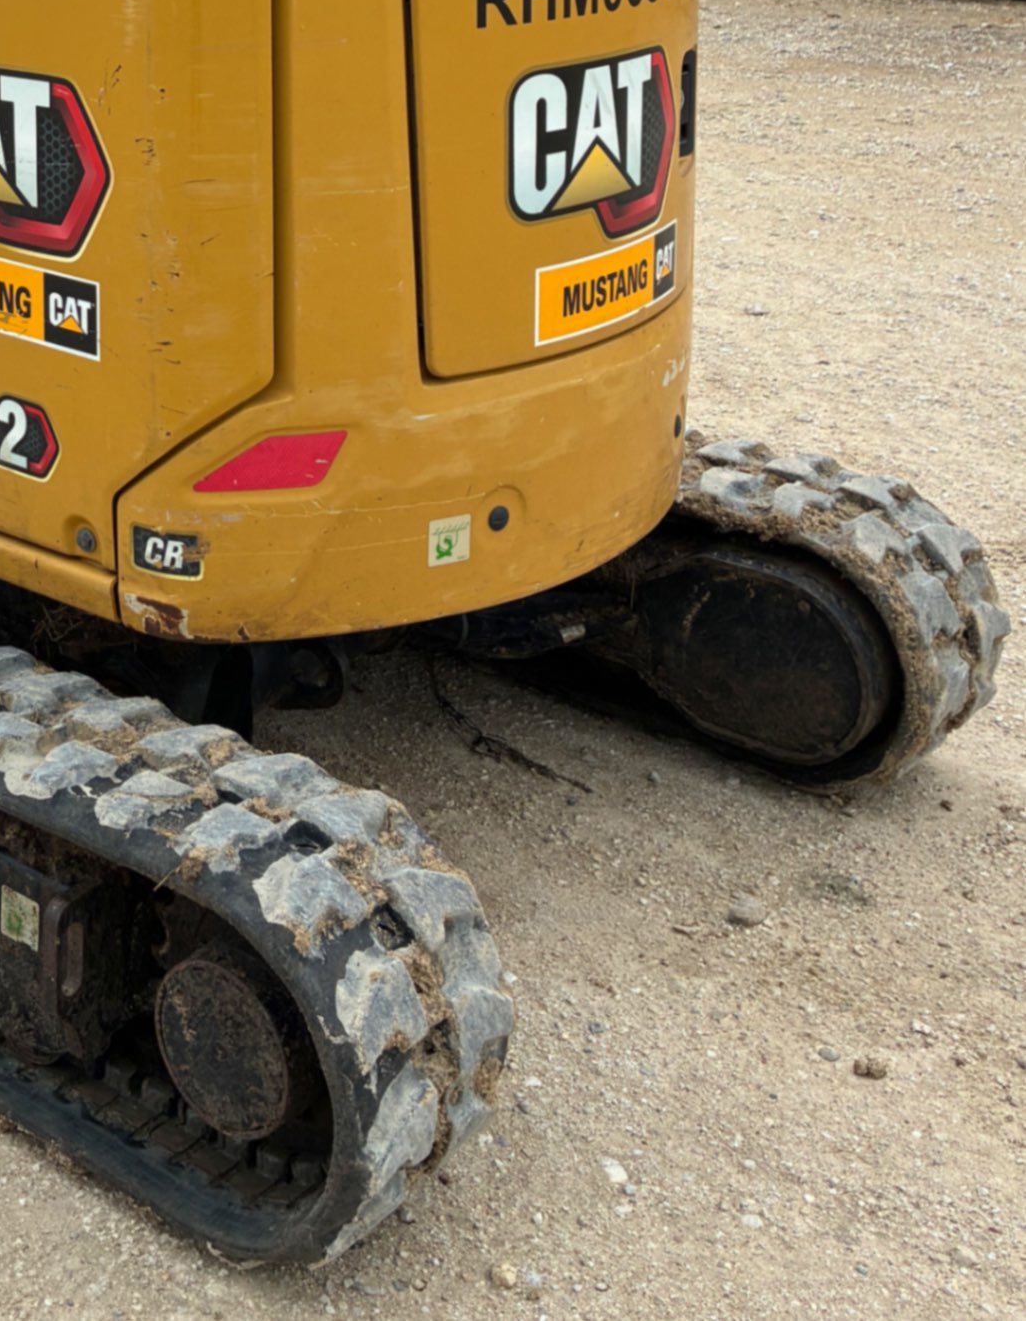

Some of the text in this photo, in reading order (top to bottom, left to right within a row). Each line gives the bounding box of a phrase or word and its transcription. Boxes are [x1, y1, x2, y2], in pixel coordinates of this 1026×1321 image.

[513, 53, 652, 215] CAT
[562, 240, 674, 318] MUSTANG CAT
[48, 291, 93, 335] CAT
[143, 535, 185, 570] CR
